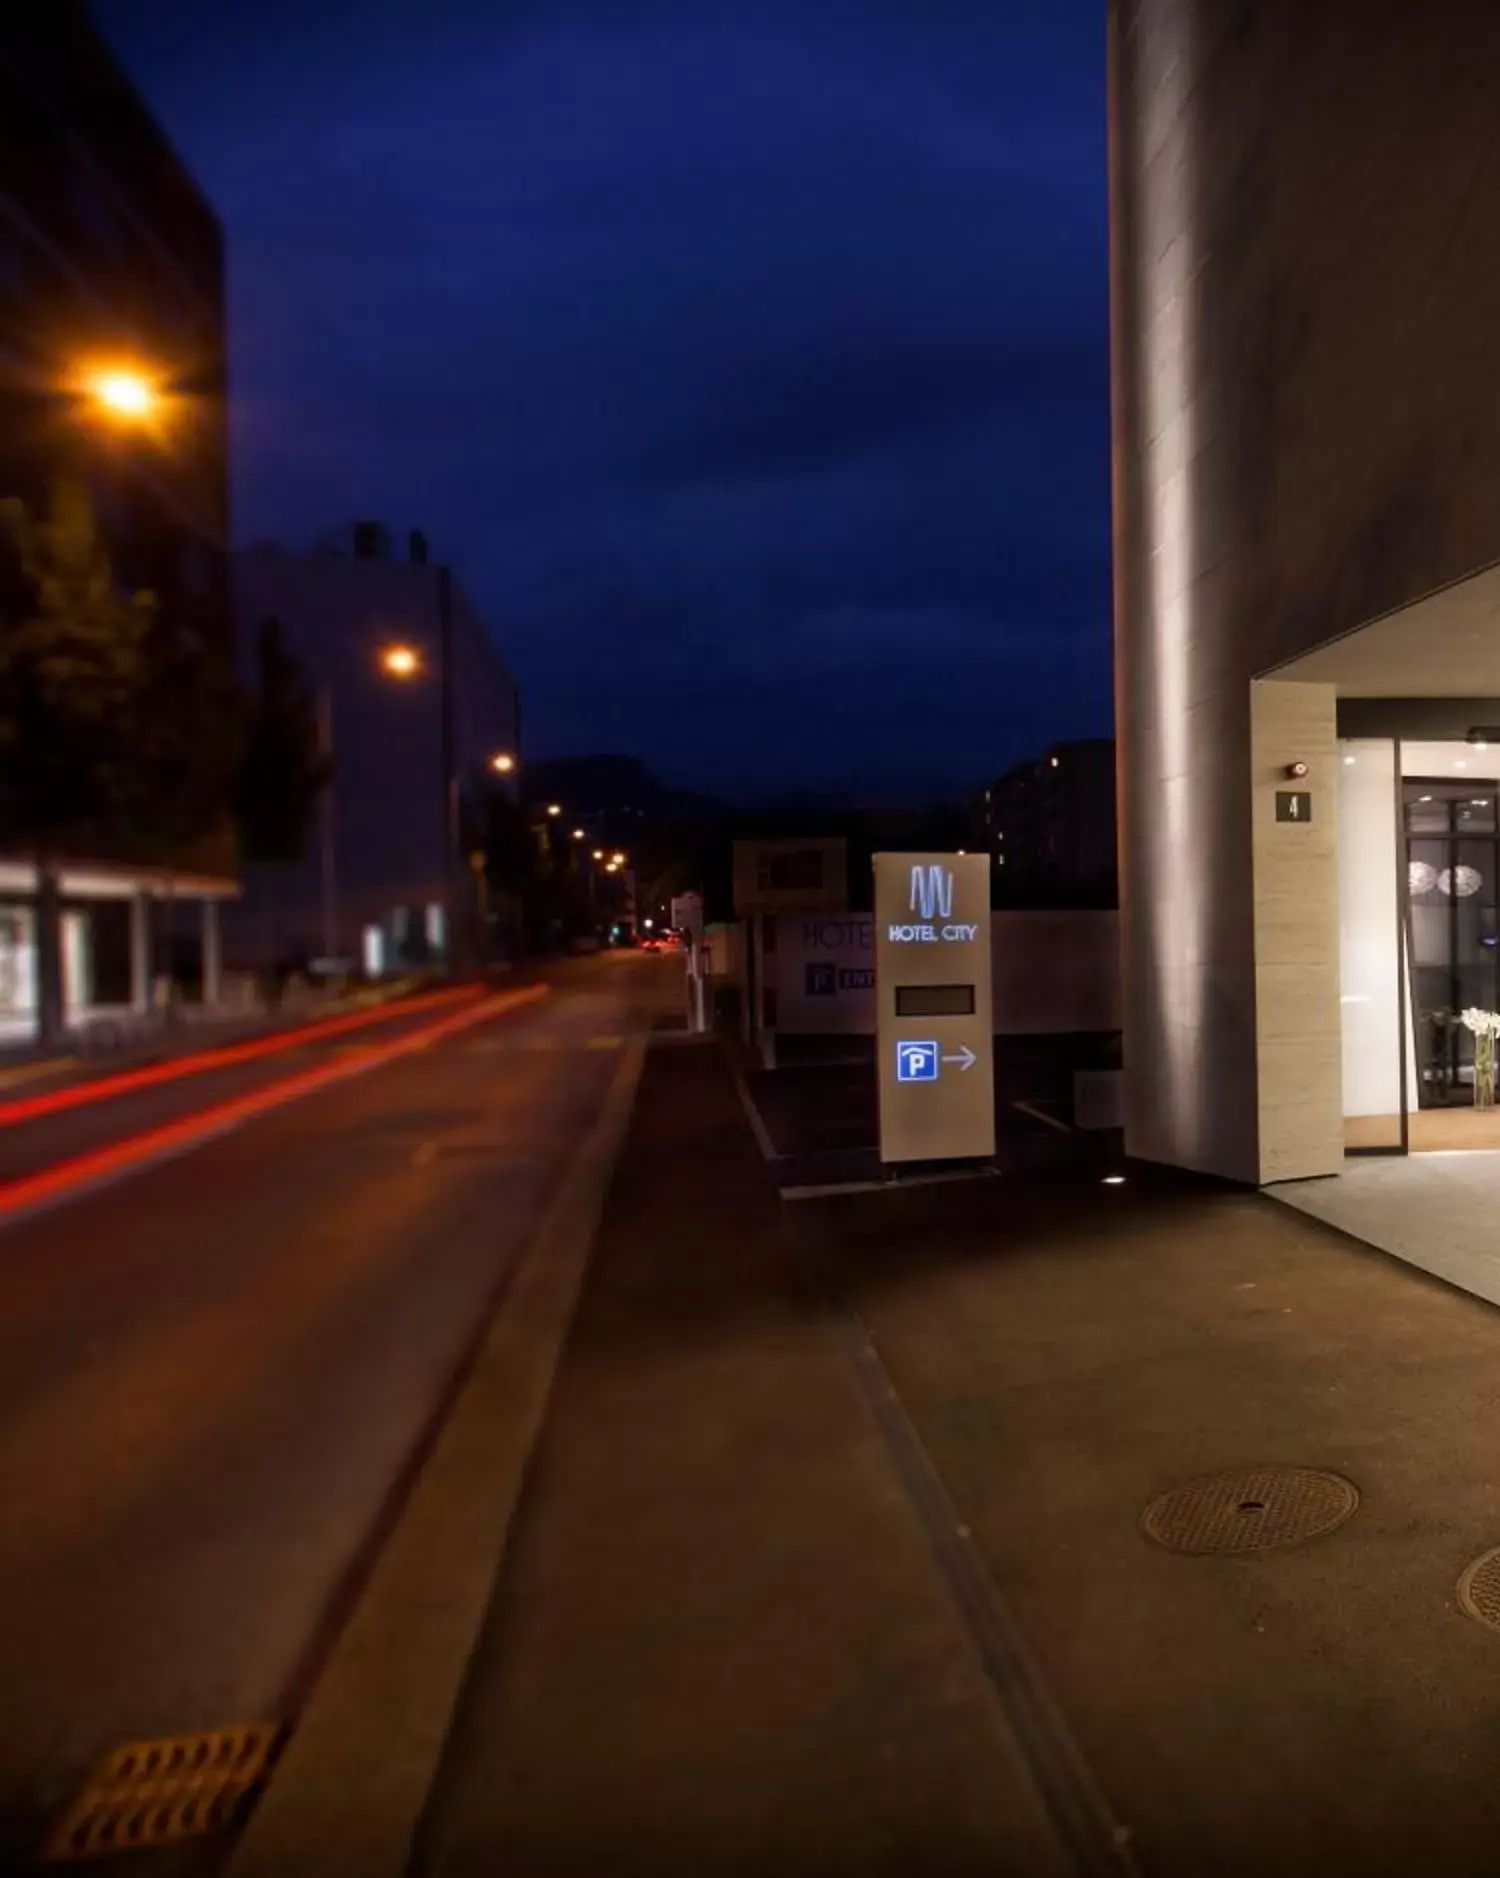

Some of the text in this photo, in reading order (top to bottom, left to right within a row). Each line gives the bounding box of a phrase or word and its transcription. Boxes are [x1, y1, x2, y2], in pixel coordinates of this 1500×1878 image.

[802, 921, 872, 949] HOTE
[889, 924, 978, 943] HOTEL CITY
[910, 1053, 925, 1077] P
